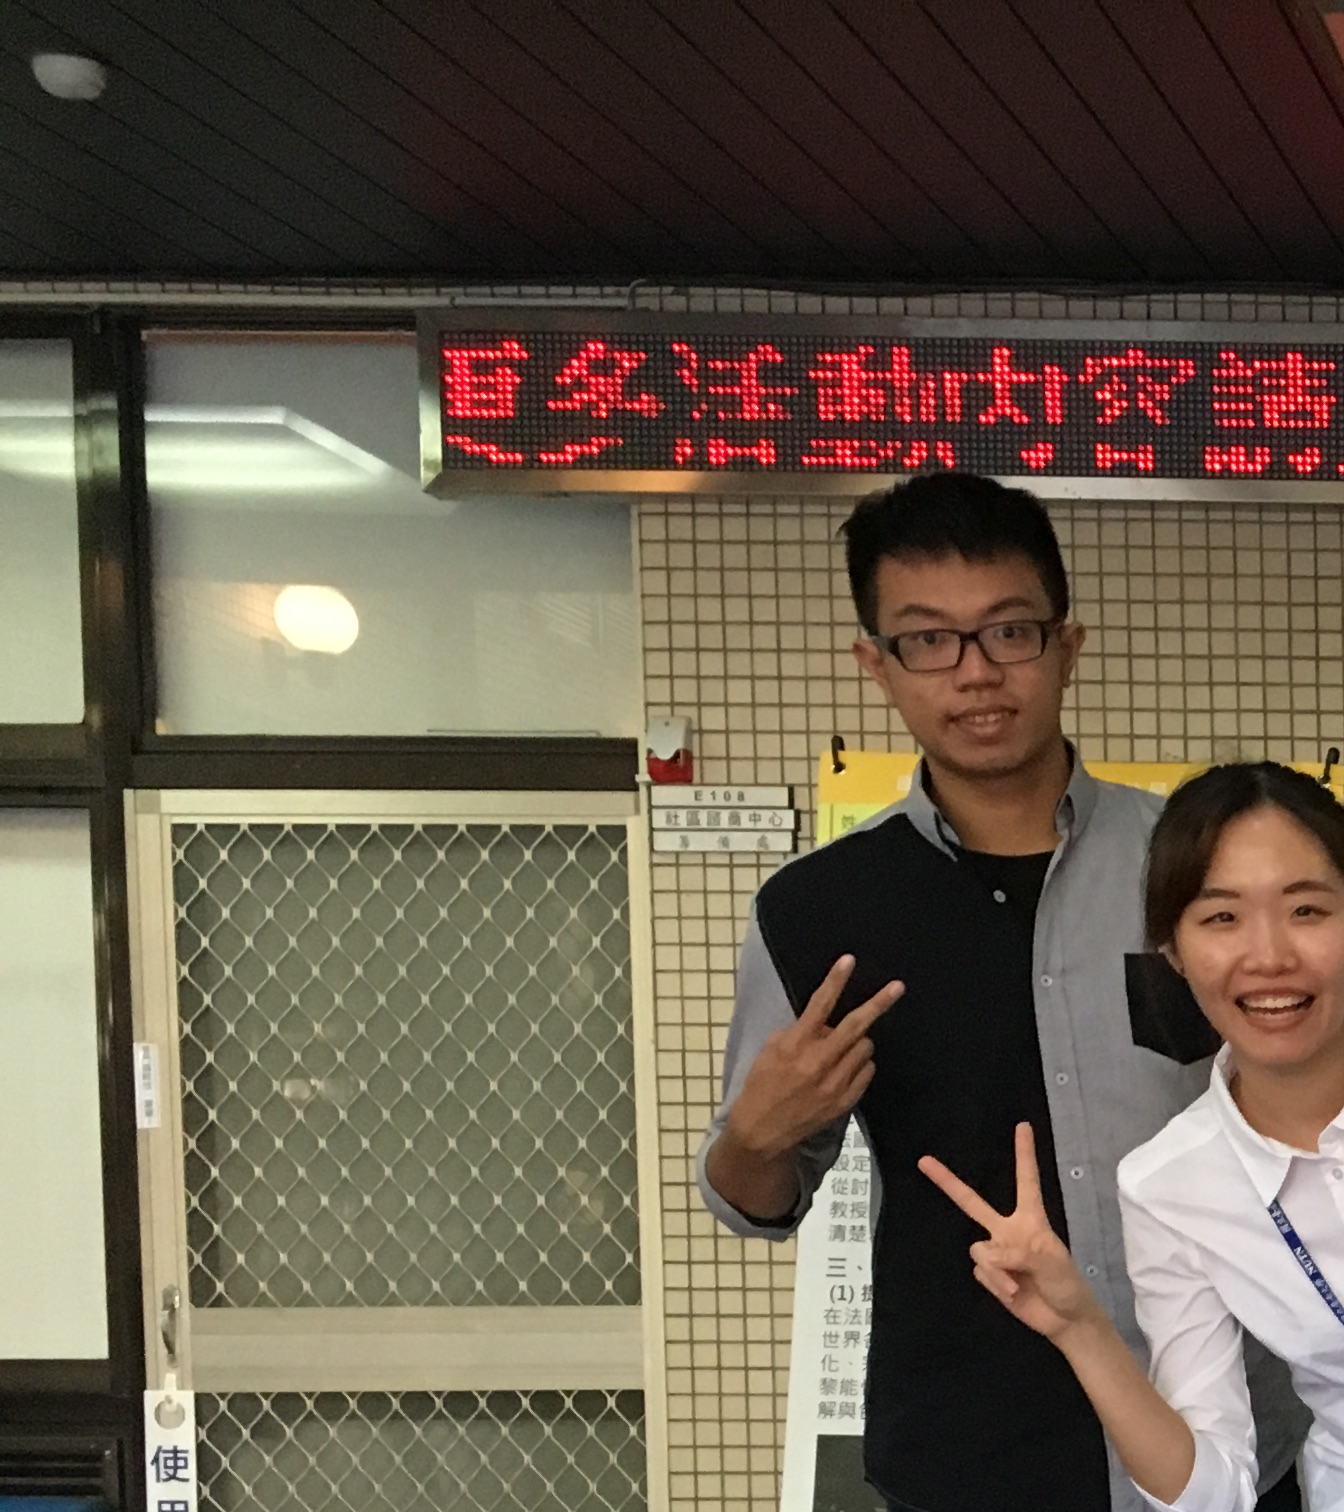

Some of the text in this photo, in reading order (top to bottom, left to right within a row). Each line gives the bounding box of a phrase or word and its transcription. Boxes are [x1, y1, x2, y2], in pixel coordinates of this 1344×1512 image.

[694, 790, 745, 803] E108
[829, 1284, 855, 1304] (1)
[819, 1377, 866, 1396] 黎能
